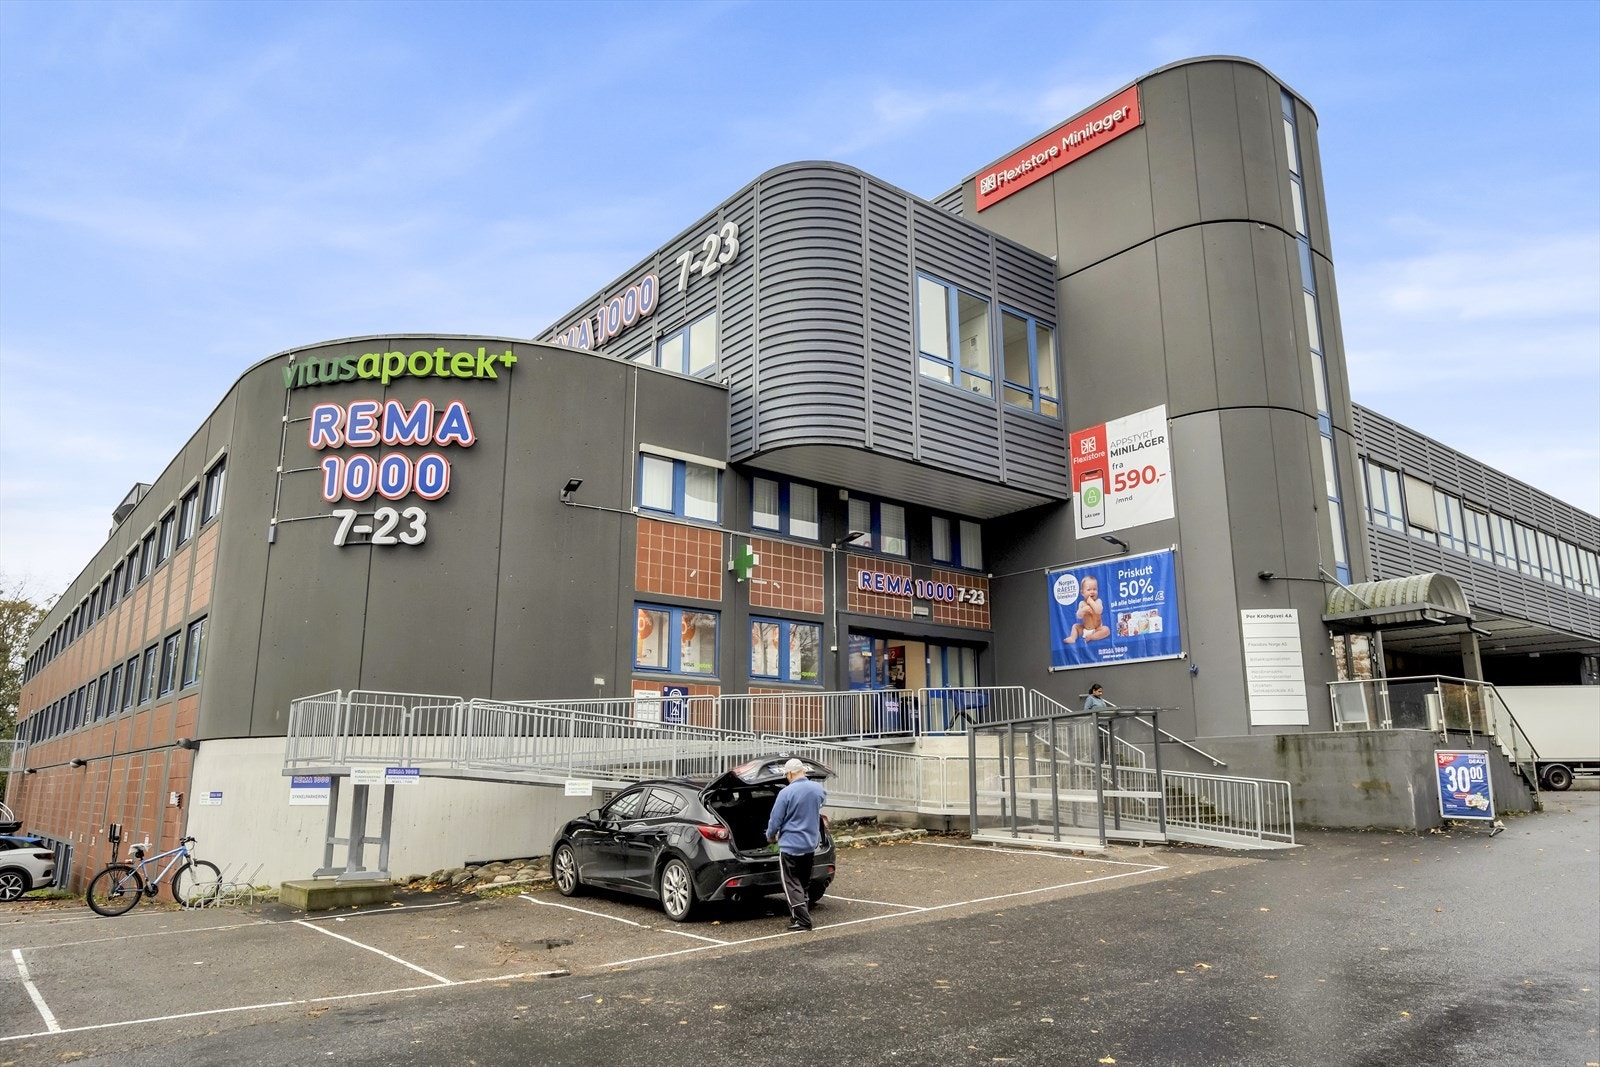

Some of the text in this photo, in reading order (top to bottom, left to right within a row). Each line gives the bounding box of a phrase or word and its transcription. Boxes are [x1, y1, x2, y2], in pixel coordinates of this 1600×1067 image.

[997, 105, 1130, 187] Flexistore Minilager
[597, 273, 660, 345] 1000
[676, 221, 740, 293] 7-23
[309, 399, 477, 449] REMA
[1110, 430, 1154, 449] APPSTYRT
[1110, 436, 1165, 458] MINILAGER
[1073, 451, 1106, 465] Flexistore
[1112, 462, 1124, 470] fra
[321, 452, 451, 502] 1000
[1114, 465, 1166, 493] 590,-
[1115, 495, 1133, 505] /mnd
[332, 507, 428, 546] 7-23
[1118, 565, 1153, 580] Priskutt
[858, 570, 985, 605] REMA 1000 7-23
[1119, 578, 1154, 598] 50%
[1438, 755, 1445, 764] 3
[293, 776, 330, 784] REMA 1000
[1445, 766, 1483, 793] 30 00
